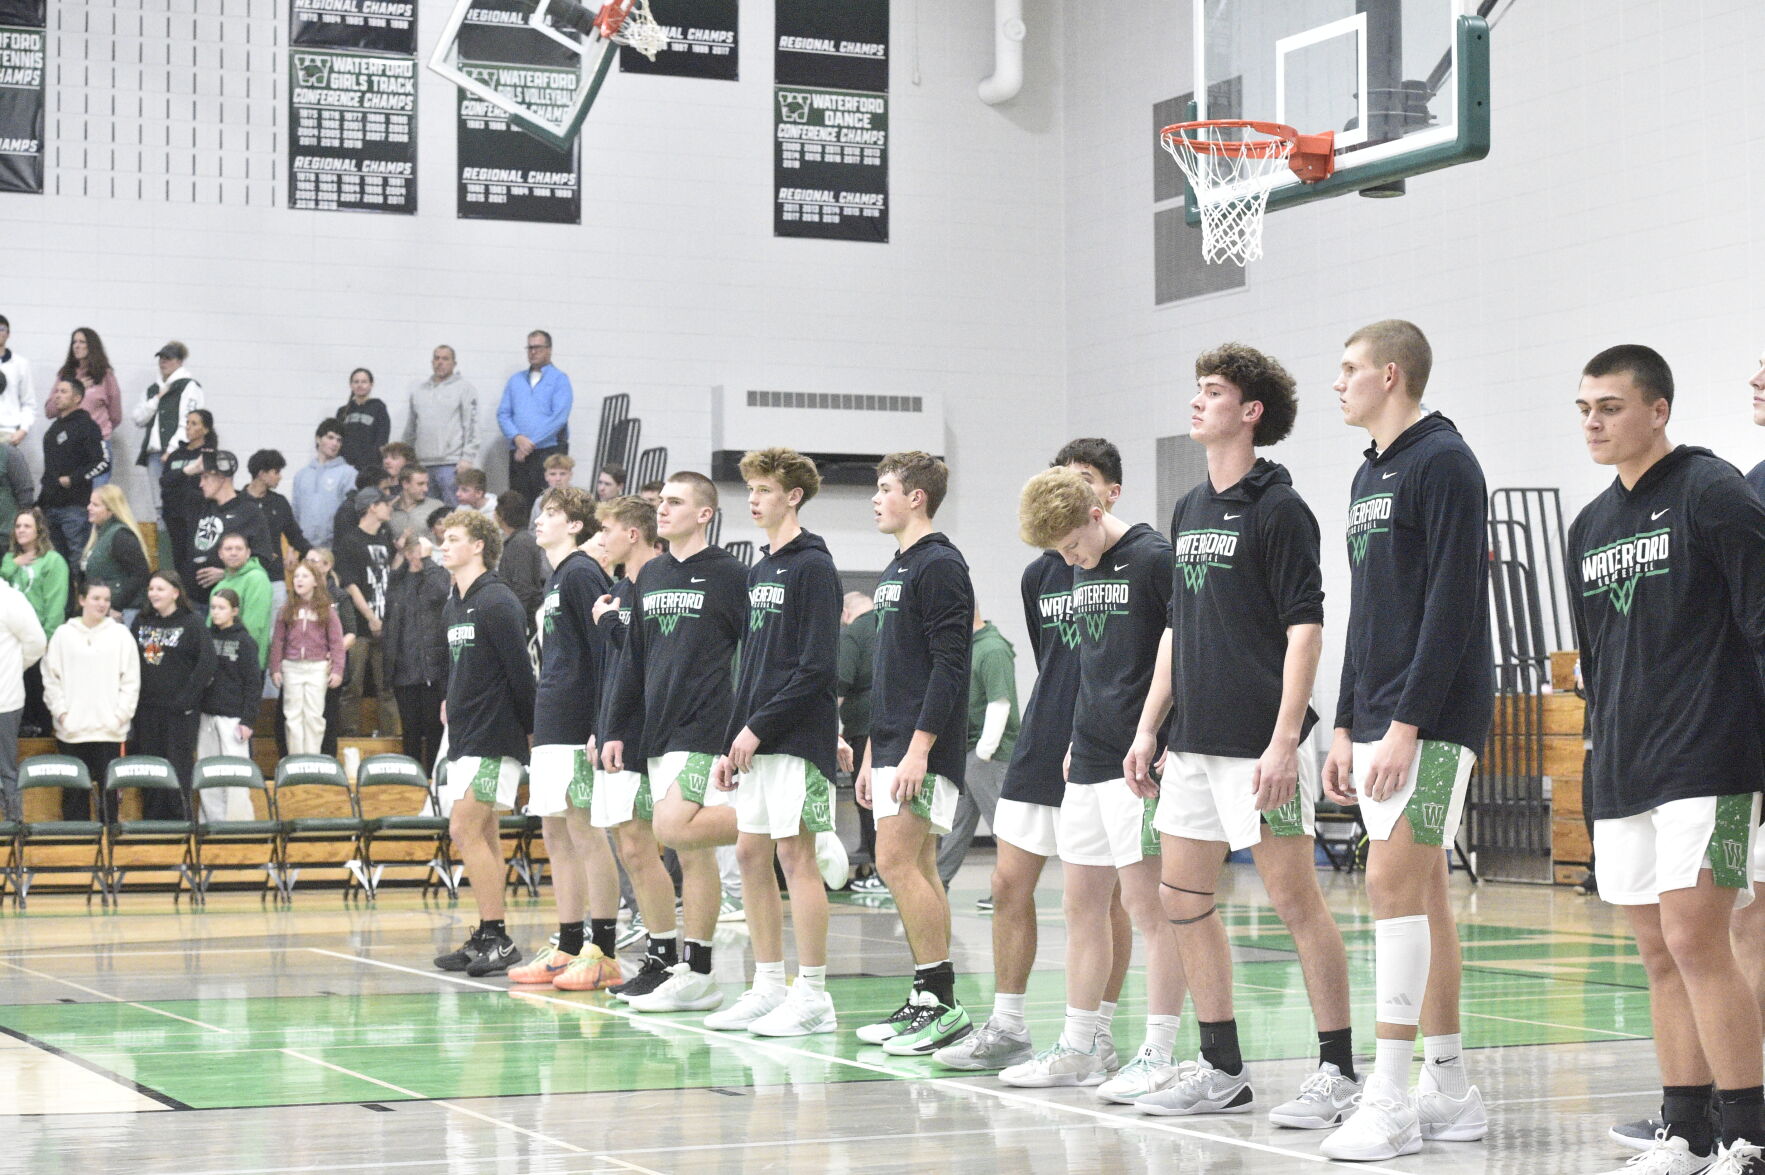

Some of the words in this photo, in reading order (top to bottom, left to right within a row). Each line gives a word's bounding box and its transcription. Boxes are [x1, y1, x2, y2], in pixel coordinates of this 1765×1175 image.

[294, 0, 358, 12] REGIONAL
[362, 1, 413, 16] CHAMPS
[0, 32, 40, 50] FORD
[687, 28, 735, 43] CHAMPS
[779, 35, 836, 52] REGIONAL
[839, 41, 885, 56] CHAMPS
[332, 56, 413, 77] WATERFORD
[330, 73, 368, 91] GIRLS
[371, 76, 414, 94] TRACK
[499, 69, 577, 89] WATERFORD
[293, 88, 361, 107] CONFERENCE
[363, 93, 413, 110] CHAMPS
[812, 93, 884, 113] WATERFORD
[824, 110, 871, 128] DANCE
[777, 123, 838, 141] CONFERENCE
[840, 128, 885, 145] CHAMPS
[0, 138, 38, 152] AMPS
[294, 156, 358, 171] REGIONAL
[362, 160, 412, 174] CHAMPS
[463, 167, 524, 183] REGIONAL
[527, 171, 576, 186] CHAMPS
[779, 187, 836, 203] REGIONAL
[839, 191, 884, 206] CHAMPS
[1582, 533, 1669, 583] WATERORD
[643, 592, 704, 611] WATERFORD
[1073, 584, 1129, 608] WATERFORD
